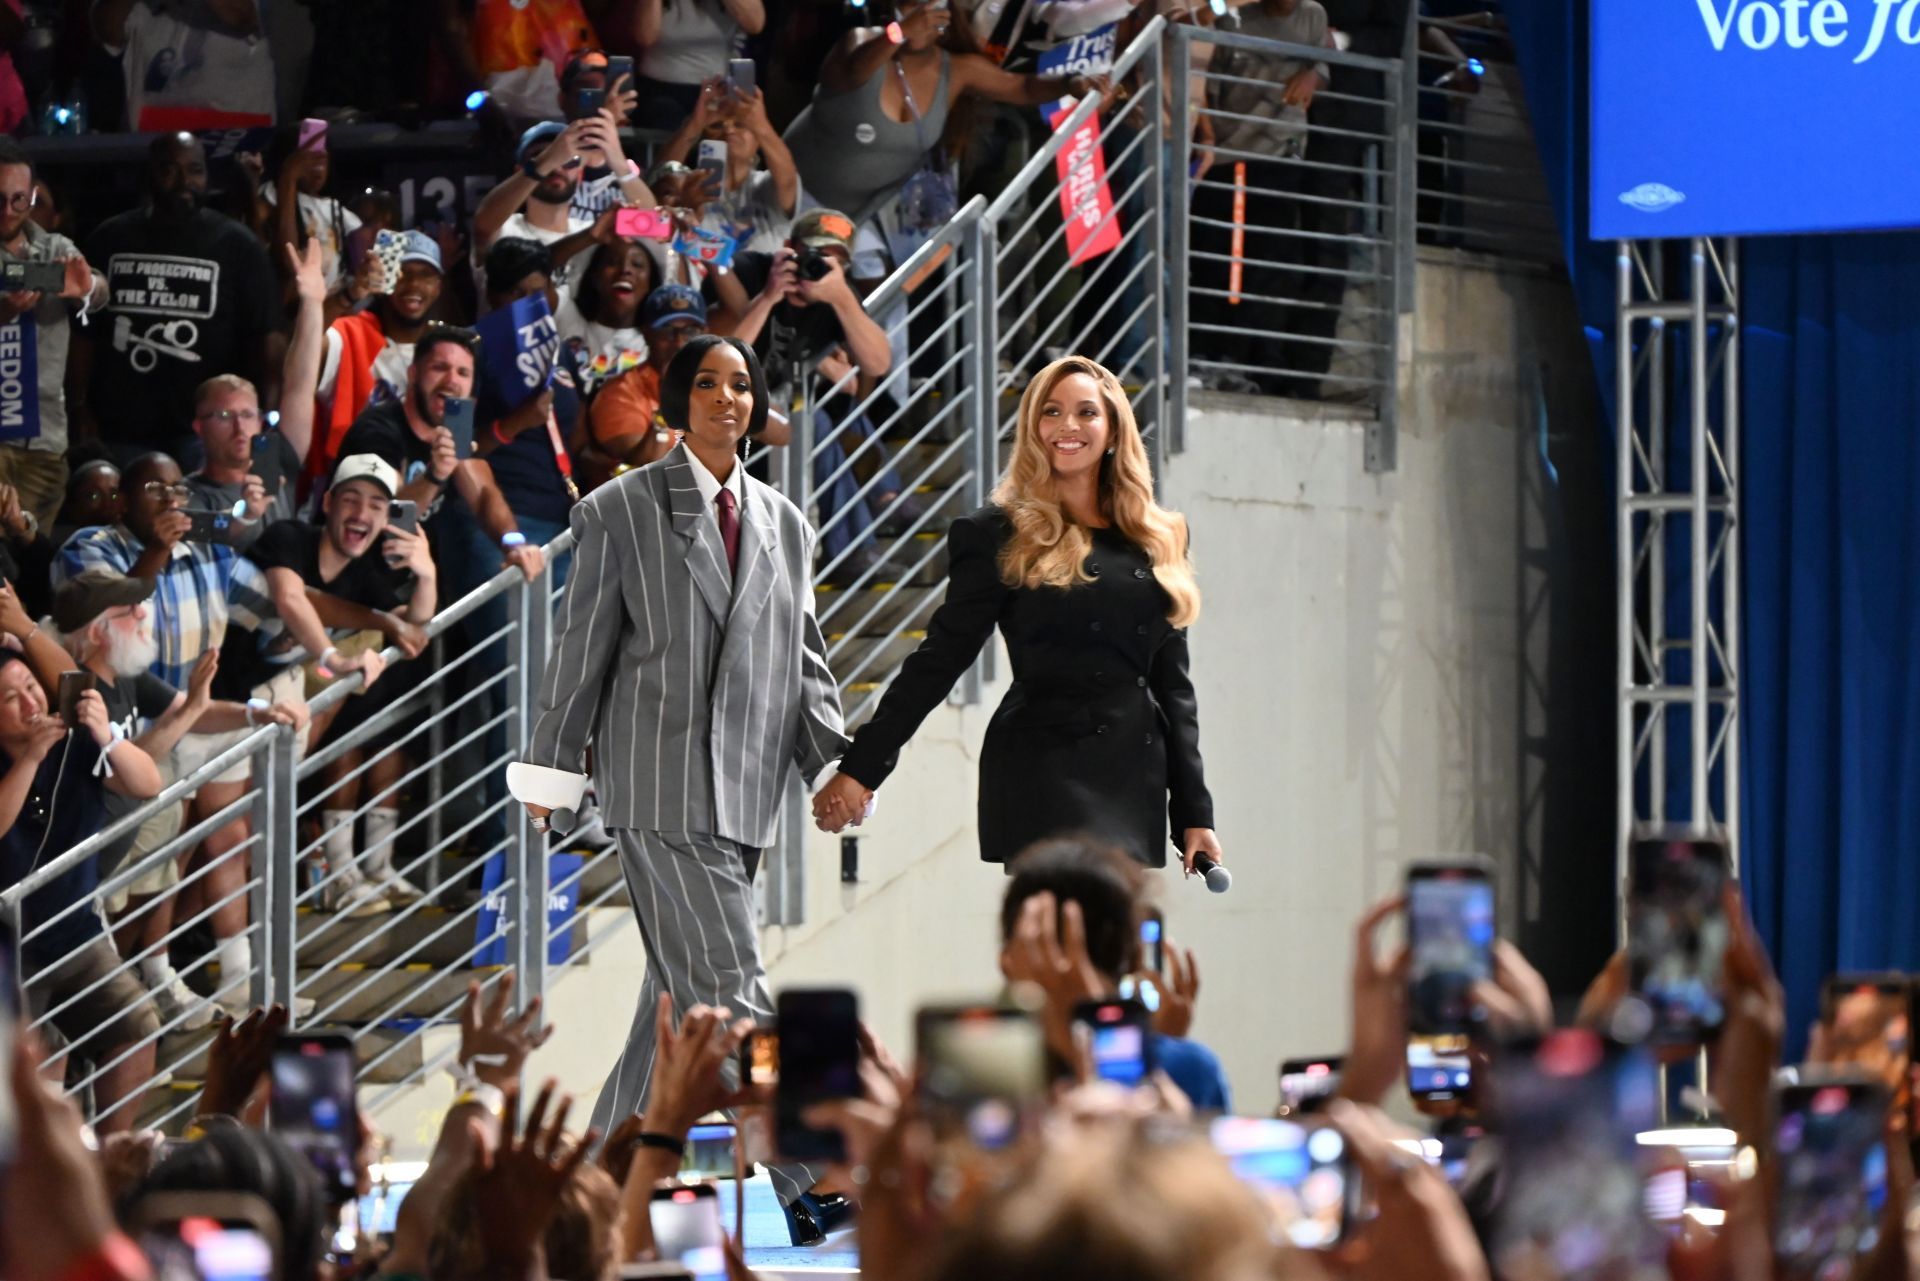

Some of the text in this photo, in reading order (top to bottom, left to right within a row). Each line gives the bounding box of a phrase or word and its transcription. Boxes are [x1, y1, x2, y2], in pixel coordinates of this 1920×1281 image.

[1695, 0, 1849, 51] Vote
[114, 261, 212, 282] THE PROSECUTOR
[148, 276, 169, 291] VS.
[116, 289, 200, 309] THE FELON
[0, 313, 24, 426] EEDOM
